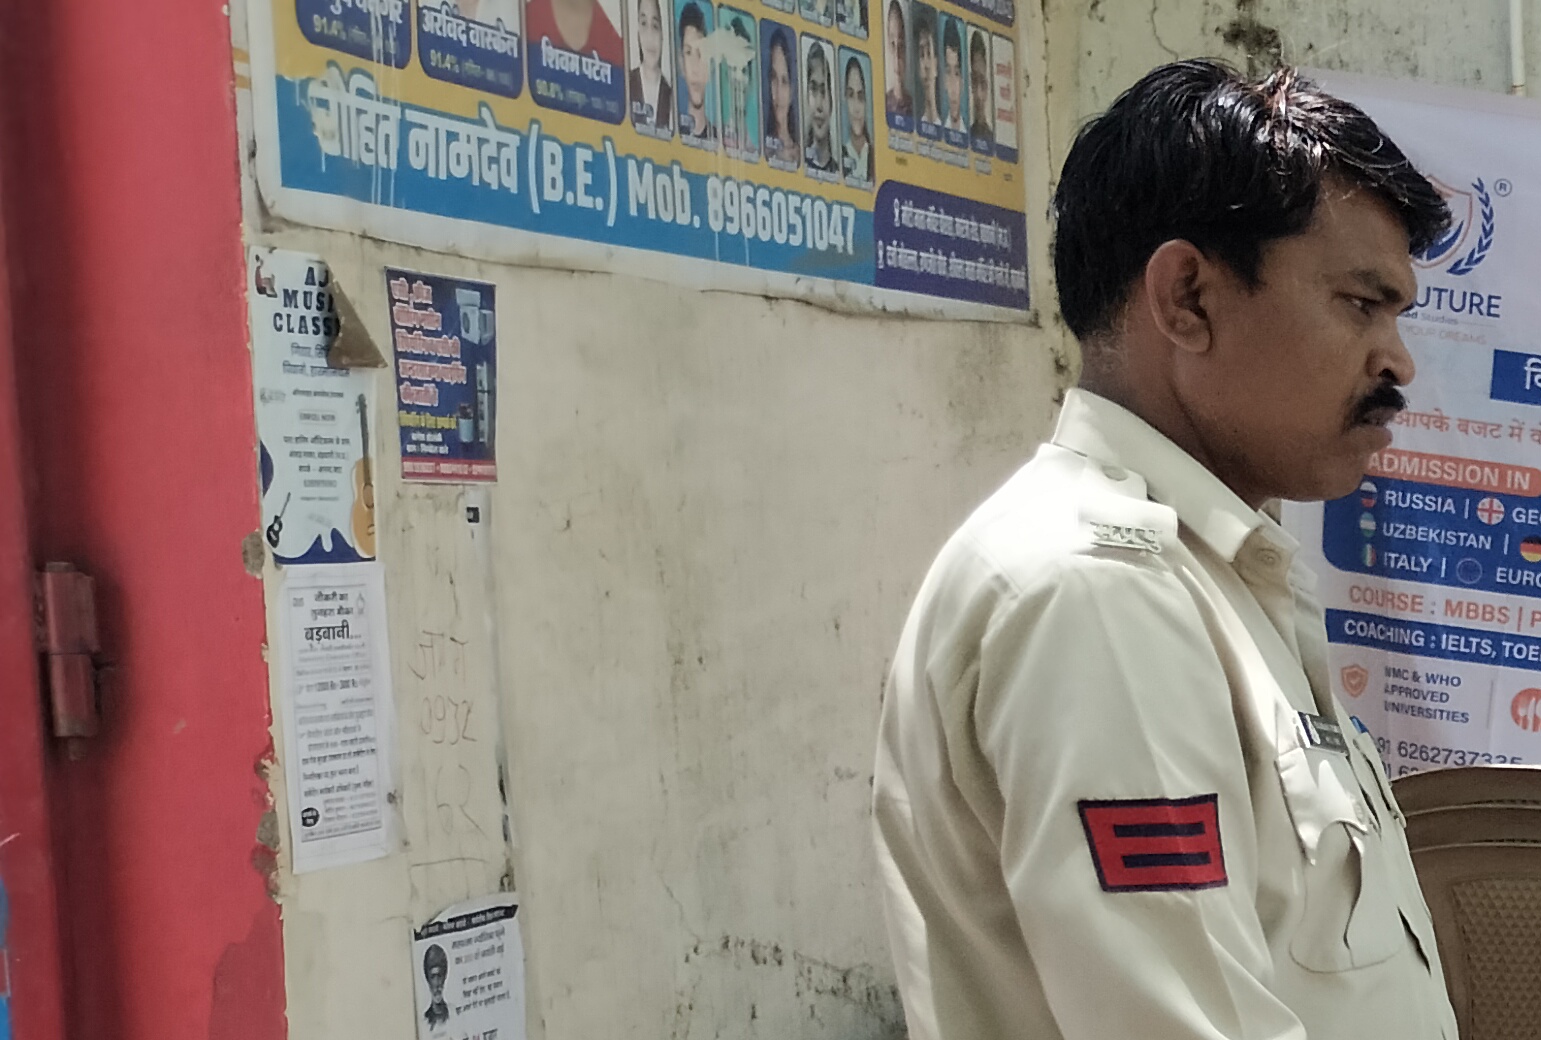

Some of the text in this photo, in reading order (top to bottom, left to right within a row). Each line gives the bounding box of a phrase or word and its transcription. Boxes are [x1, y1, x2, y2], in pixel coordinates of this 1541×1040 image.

[582, 50, 612, 84] पटेल
[405, 106, 521, 194] नामदेव
[528, 123, 617, 227] (B.E.)
[627, 159, 700, 229] Mob.
[707, 175, 855, 255] 8966051047
[1457, 417, 1502, 439] बजट
[1508, 418, 1525, 443] में
[1367, 451, 1531, 491] ADMISSION IN
[1384, 490, 1456, 515] RUSSIA
[1382, 522, 1492, 550] UZBEKISTAN
[1383, 552, 1432, 573] ITALY
[1349, 585, 1424, 613] COURSE
[1444, 599, 1511, 625] MBBS
[1344, 619, 1425, 647] COACHING
[1441, 633, 1497, 659] IELTS,
[1384, 665, 1462, 687] NMC & WHO
[1384, 683, 1450, 704] APPROVED
[1384, 700, 1470, 724] UNIVERSITIES
